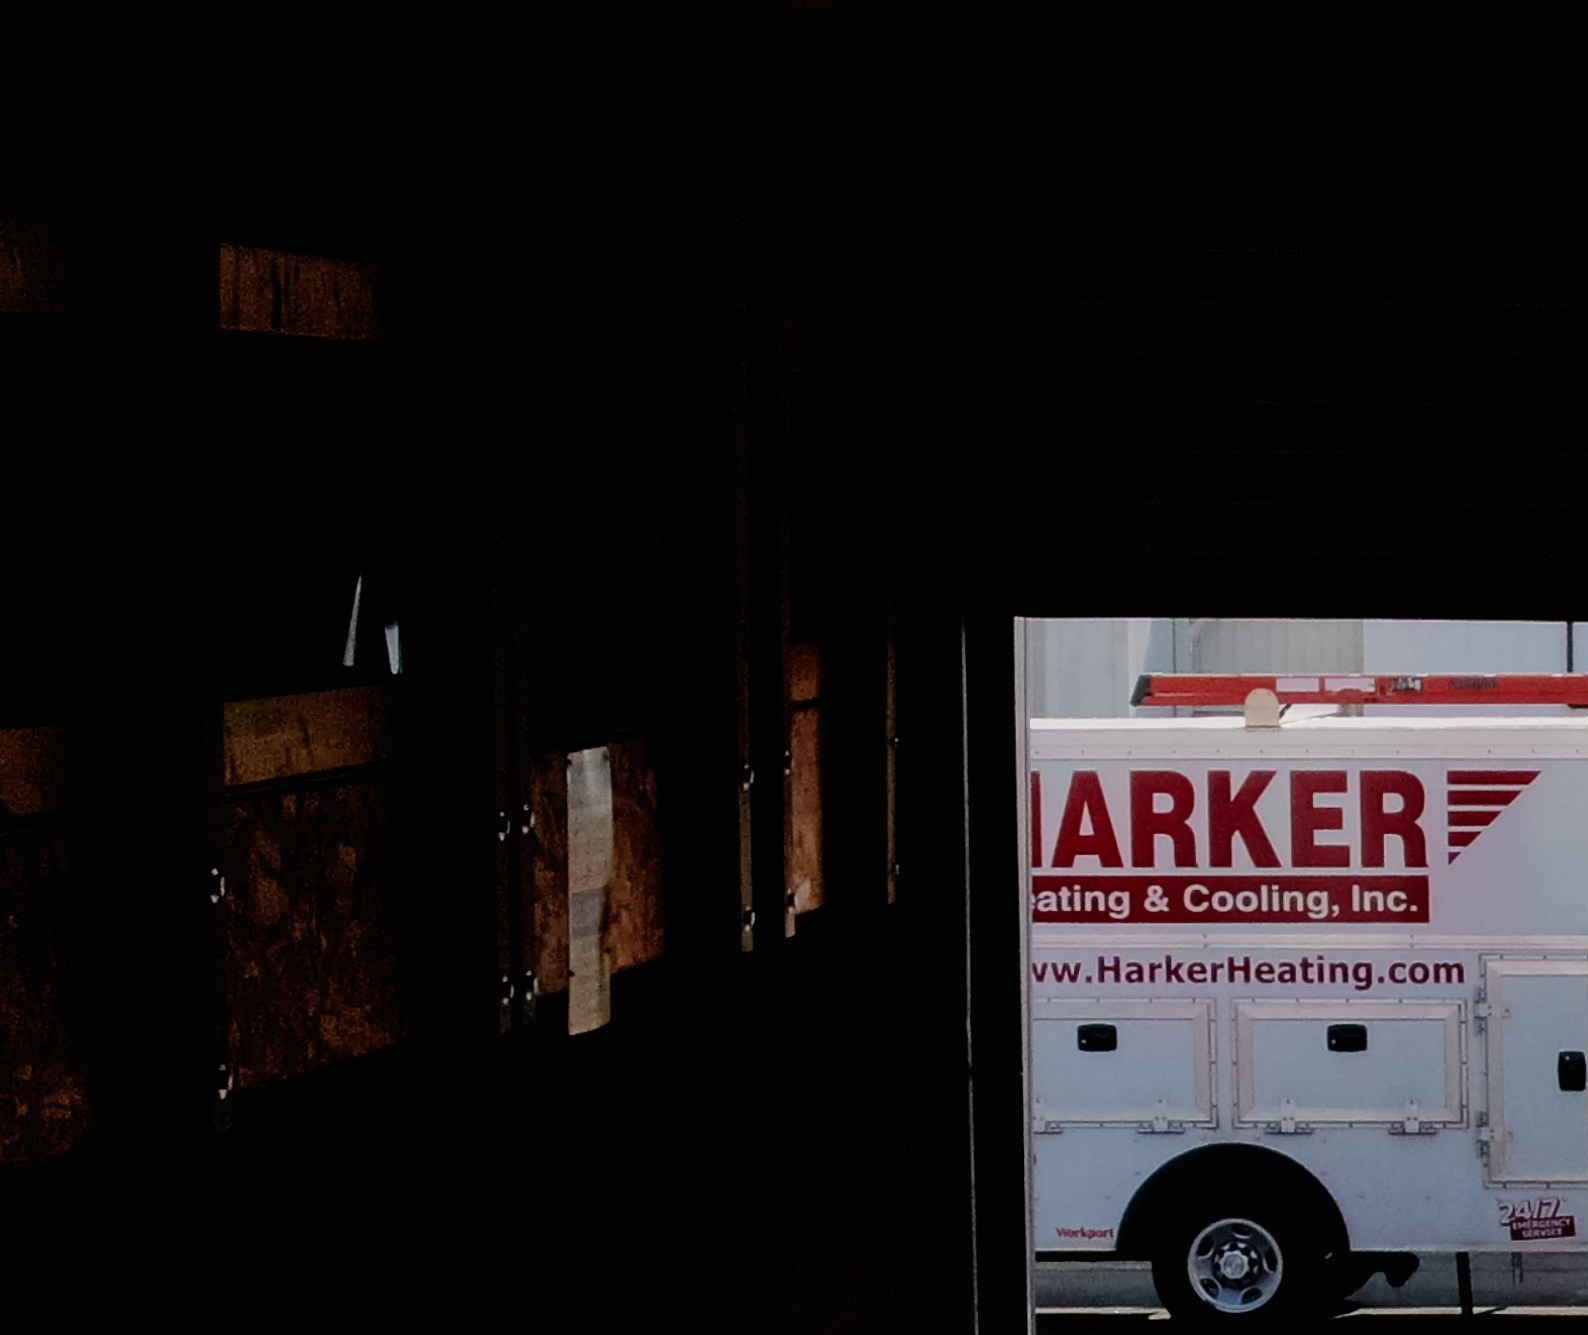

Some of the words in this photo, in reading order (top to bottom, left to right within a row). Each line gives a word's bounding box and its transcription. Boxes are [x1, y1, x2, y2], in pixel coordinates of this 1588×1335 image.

[1030, 770, 1429, 868] ARKER
[1143, 885, 1170, 912] &
[1183, 884, 1340, 919] Cooling,
[1352, 884, 1418, 912] Inc.
[1498, 1198, 1561, 1227] 24/7
